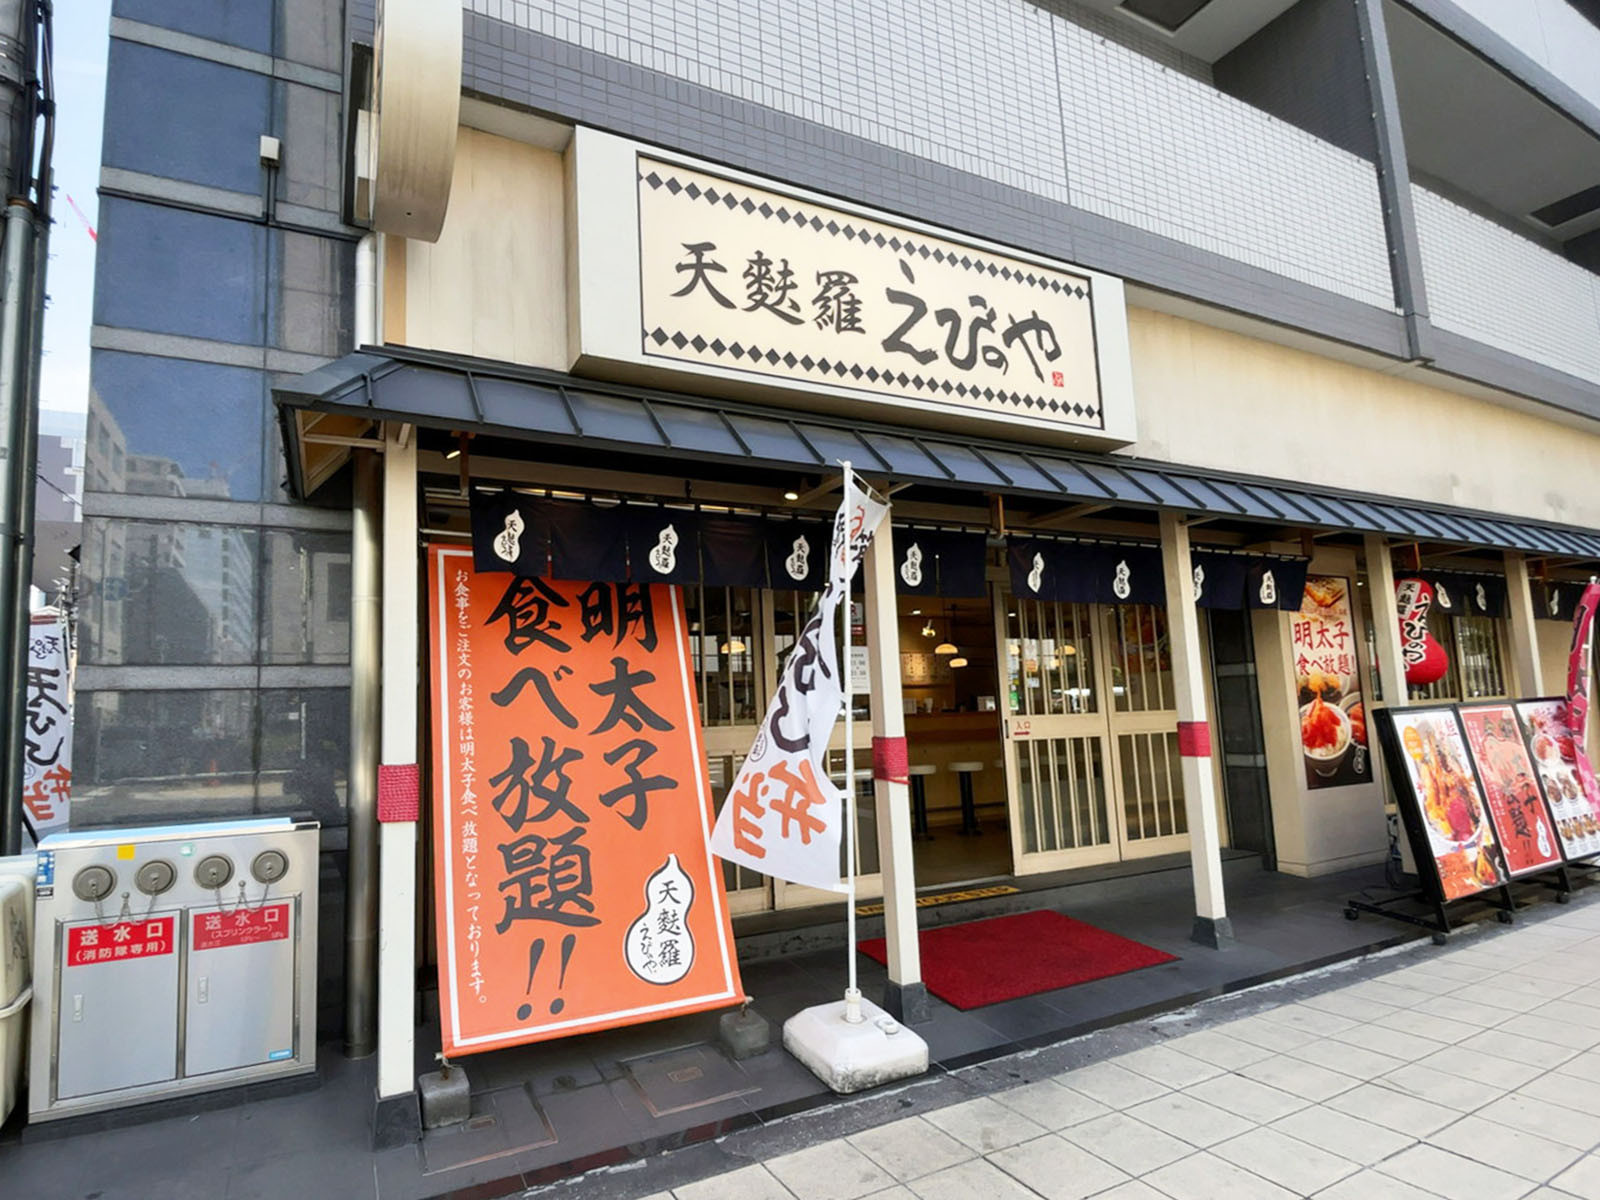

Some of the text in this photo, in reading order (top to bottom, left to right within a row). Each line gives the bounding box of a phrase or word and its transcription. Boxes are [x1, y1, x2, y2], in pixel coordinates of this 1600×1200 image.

[1294, 620, 1350, 651] 明太子
[575, 580, 679, 831] 明太子
[80, 921, 164, 947] 送水口
[205, 908, 280, 931] 送水口
[657, 879, 682, 968] 天麩羅
